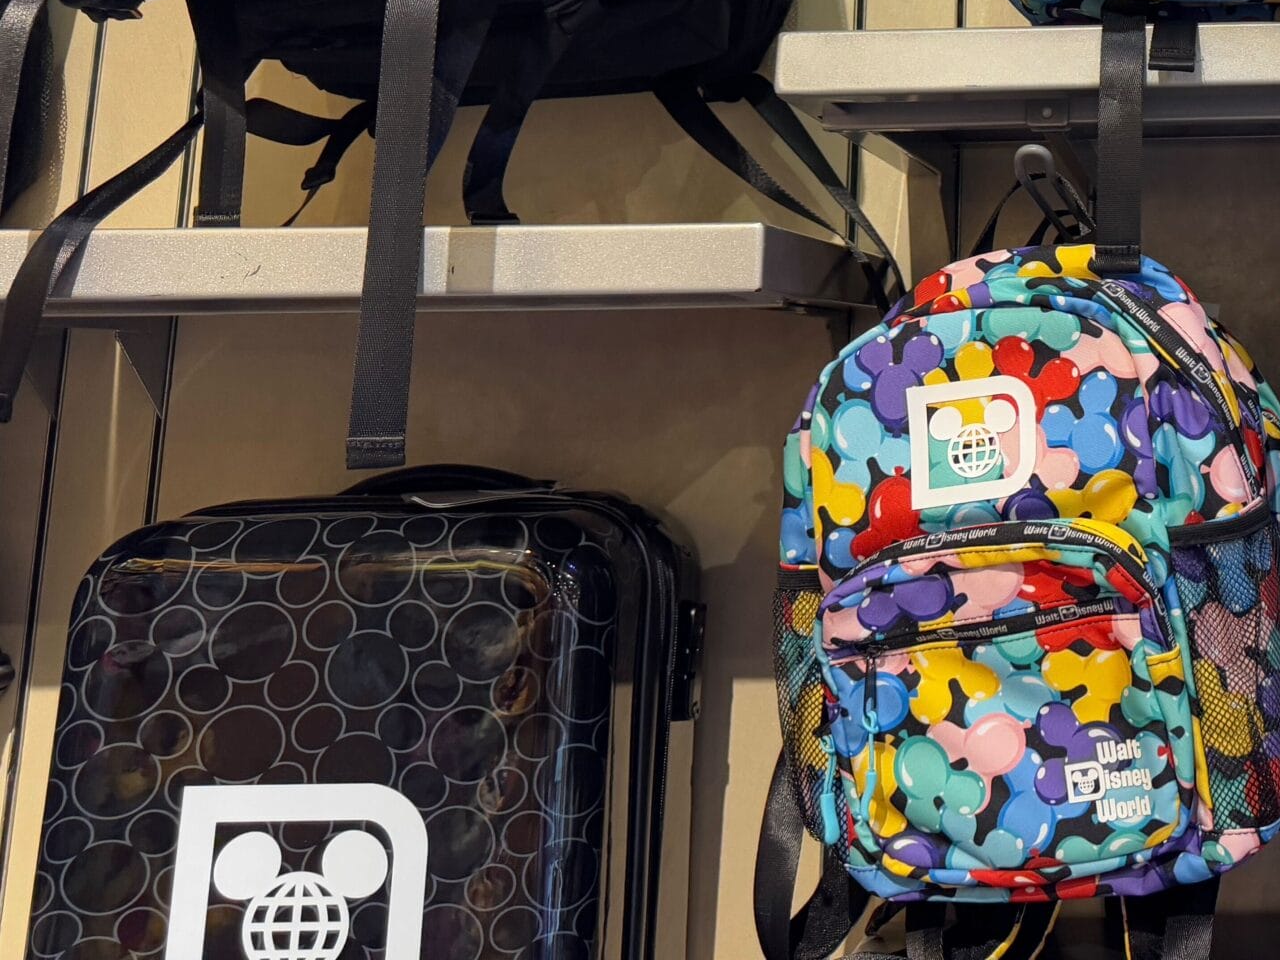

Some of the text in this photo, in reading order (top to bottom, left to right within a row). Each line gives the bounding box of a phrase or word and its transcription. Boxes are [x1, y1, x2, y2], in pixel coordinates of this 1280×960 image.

[1102, 282, 1160, 333] Disney World
[1174, 346, 1196, 369] Walt
[1191, 362, 1224, 406] Disney
[903, 527, 998, 550] Walt Disney World
[1023, 524, 1123, 554] Walt Disney World
[1034, 613, 1060, 625] Walt
[1058, 604, 1104, 622] Disney
[937, 628, 981, 640] Disney
[979, 624, 1008, 637] World
[1095, 738, 1142, 765] Walt
[1064, 760, 1153, 804] Disney
[1095, 794, 1152, 824] World
